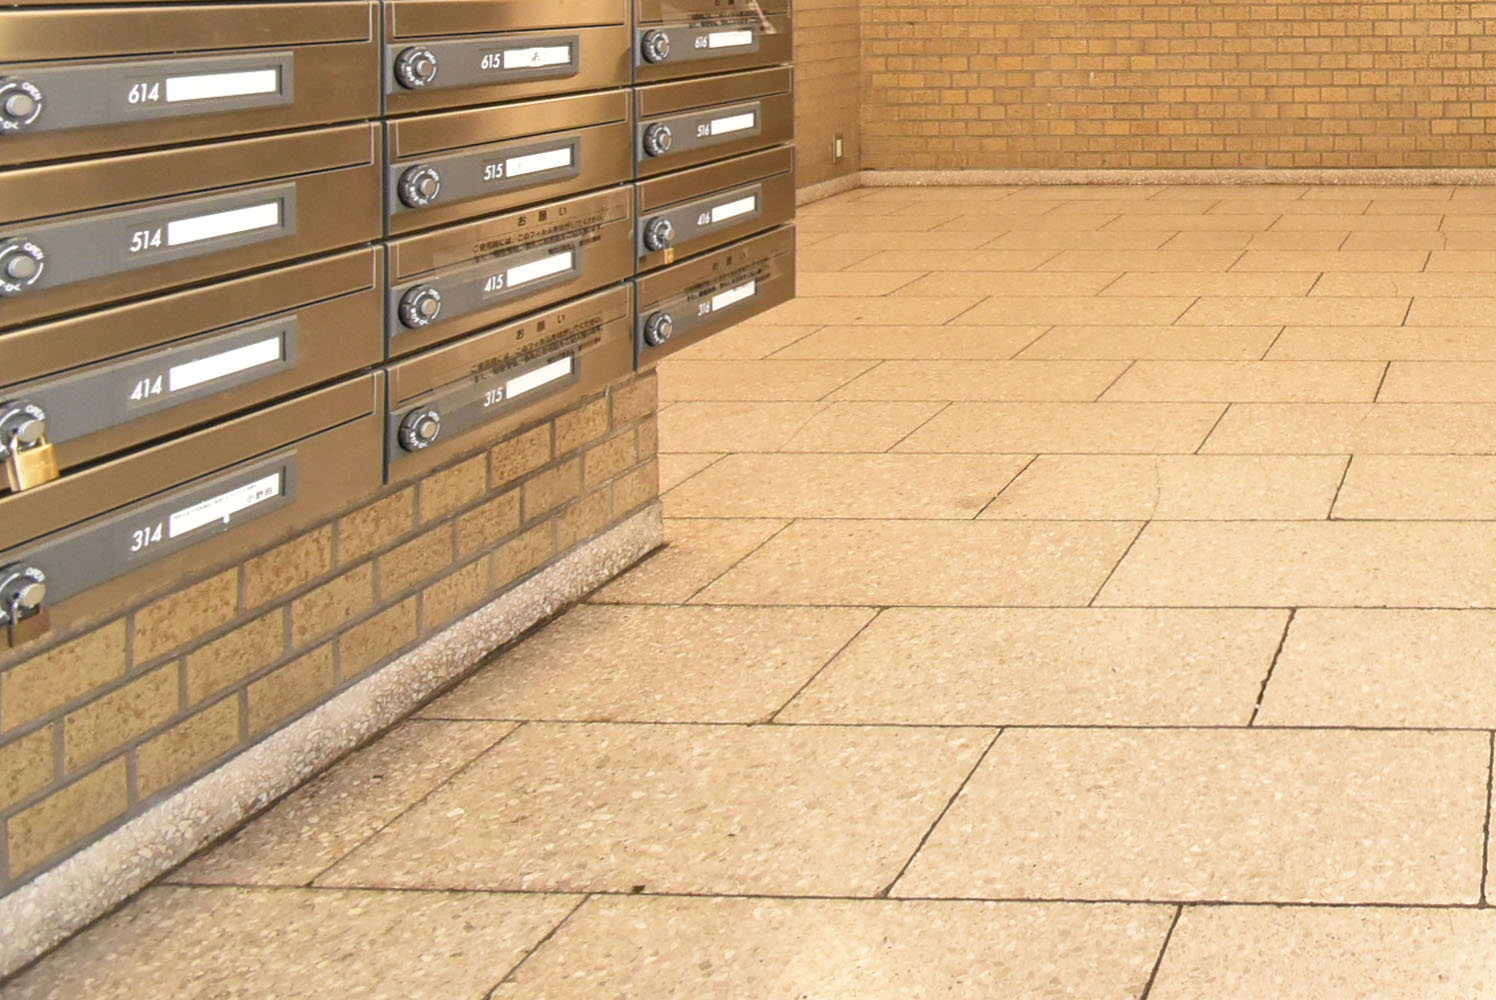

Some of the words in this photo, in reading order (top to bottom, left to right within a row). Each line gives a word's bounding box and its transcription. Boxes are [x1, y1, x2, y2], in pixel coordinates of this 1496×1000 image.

[481, 53, 501, 70] 615
[21, 82, 43, 101] OPEN
[128, 83, 160, 104] 614
[484, 164, 503, 181] 515
[130, 229, 162, 252] 514
[23, 242, 45, 261] OPEN
[484, 272, 503, 292] 415
[130, 375, 162, 401] 414
[484, 388, 503, 407] 315
[25, 404, 46, 421] OPEN
[131, 523, 162, 552] 314
[25, 566, 46, 583] OPEN
